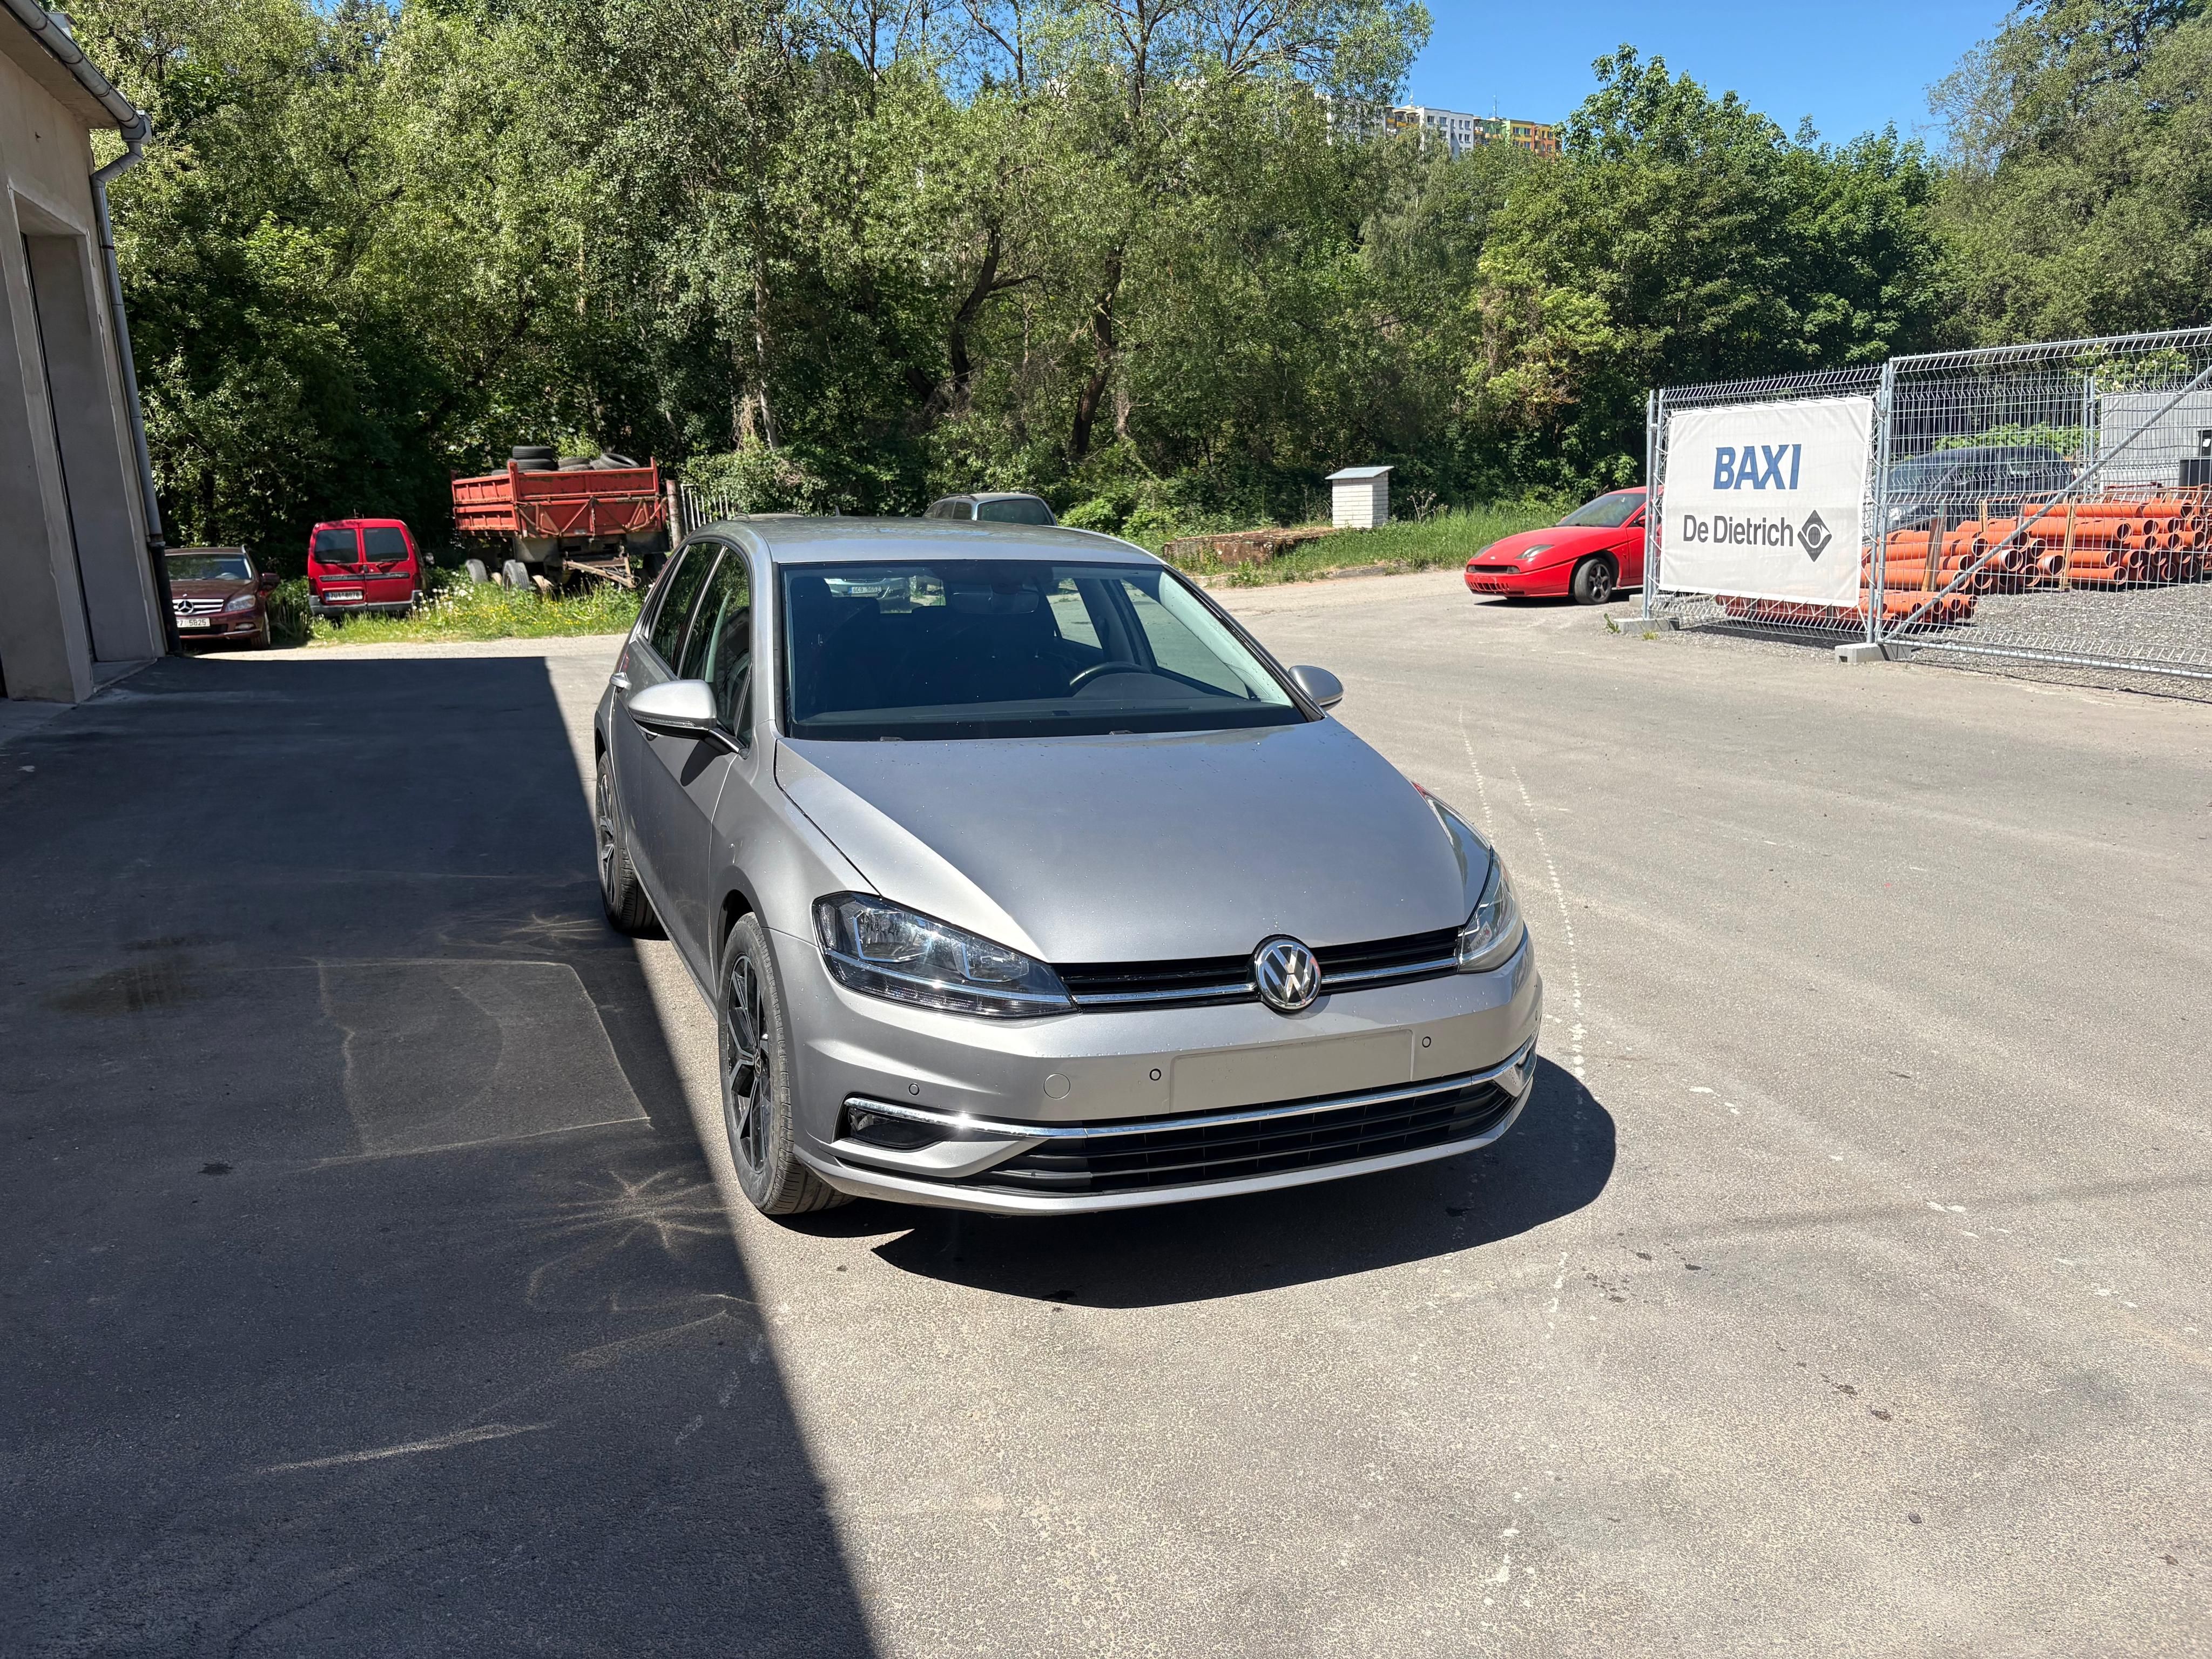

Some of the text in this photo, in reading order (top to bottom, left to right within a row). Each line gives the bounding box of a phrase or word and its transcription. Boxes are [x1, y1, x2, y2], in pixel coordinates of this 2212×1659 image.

[1713, 444, 1802, 489] BAXI
[1683, 515, 1793, 547] De Dietrich
